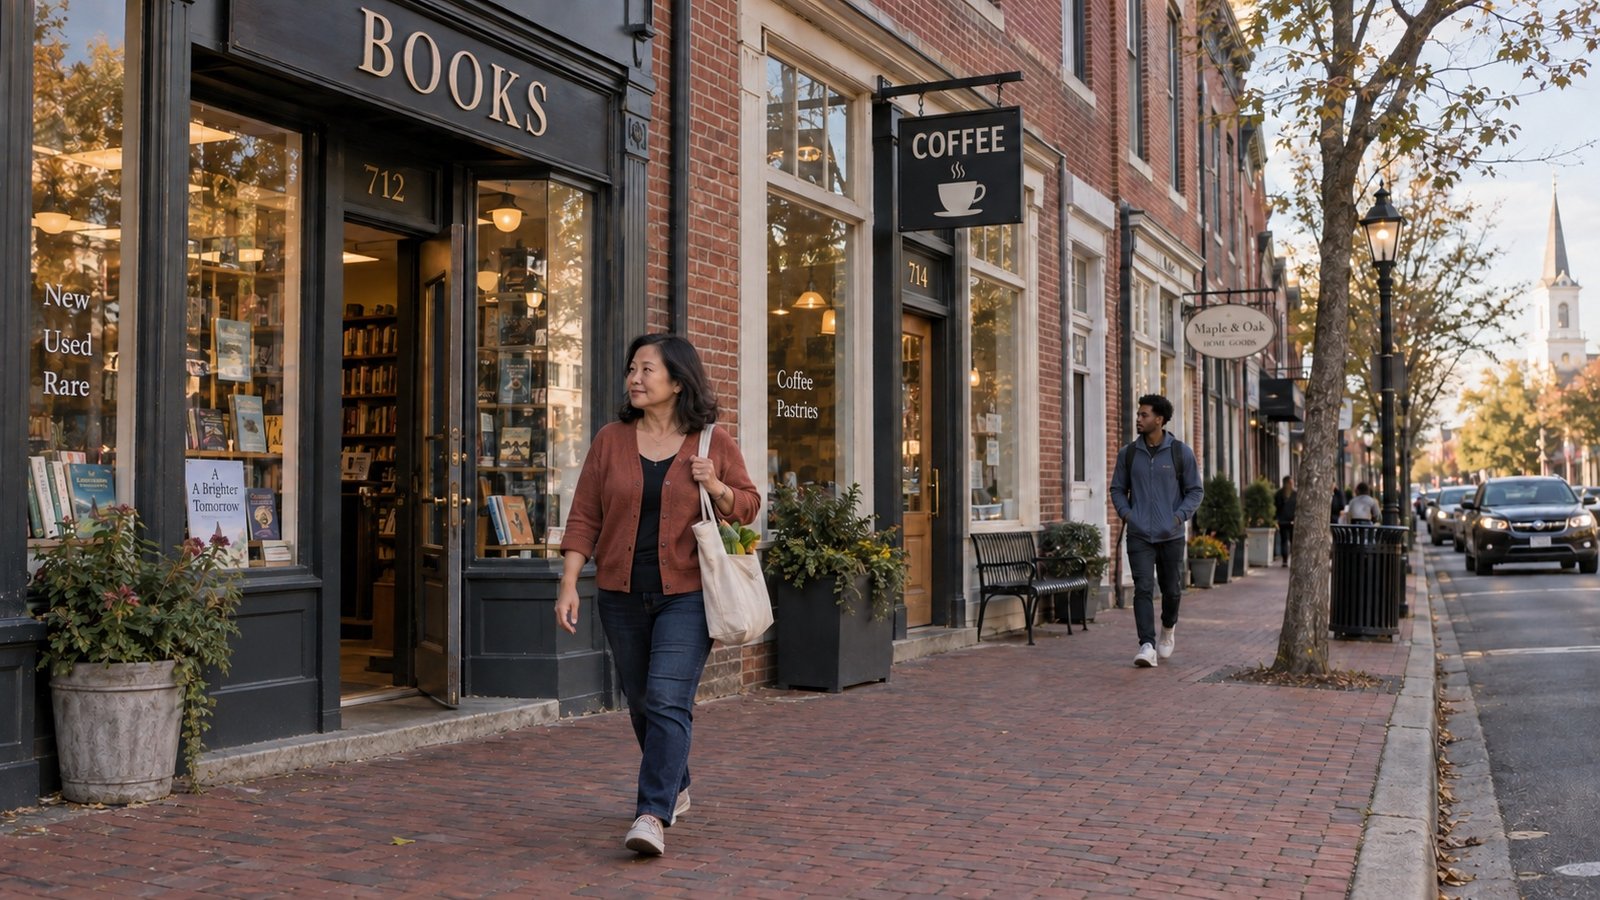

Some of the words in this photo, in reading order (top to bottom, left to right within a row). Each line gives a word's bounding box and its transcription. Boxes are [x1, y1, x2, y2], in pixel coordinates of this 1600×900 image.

[358, 7, 548, 137] BOOKS
[912, 125, 1005, 159] COFFEE
[364, 164, 405, 202] 712
[908, 261, 928, 288] 714
[43, 282, 91, 310] New
[1194, 322, 1227, 336] Maple
[1230, 323, 1240, 333] &
[1242, 321, 1266, 332] Oak
[43, 329, 93, 356] Used
[43, 371, 91, 397] Rare
[777, 370, 814, 390] Coffee
[776, 399, 819, 419] Pastries
[211, 468, 219, 480] A
[192, 483, 200, 495] A
[202, 482, 239, 498] Brighter
[193, 499, 240, 512] Tomorrow
